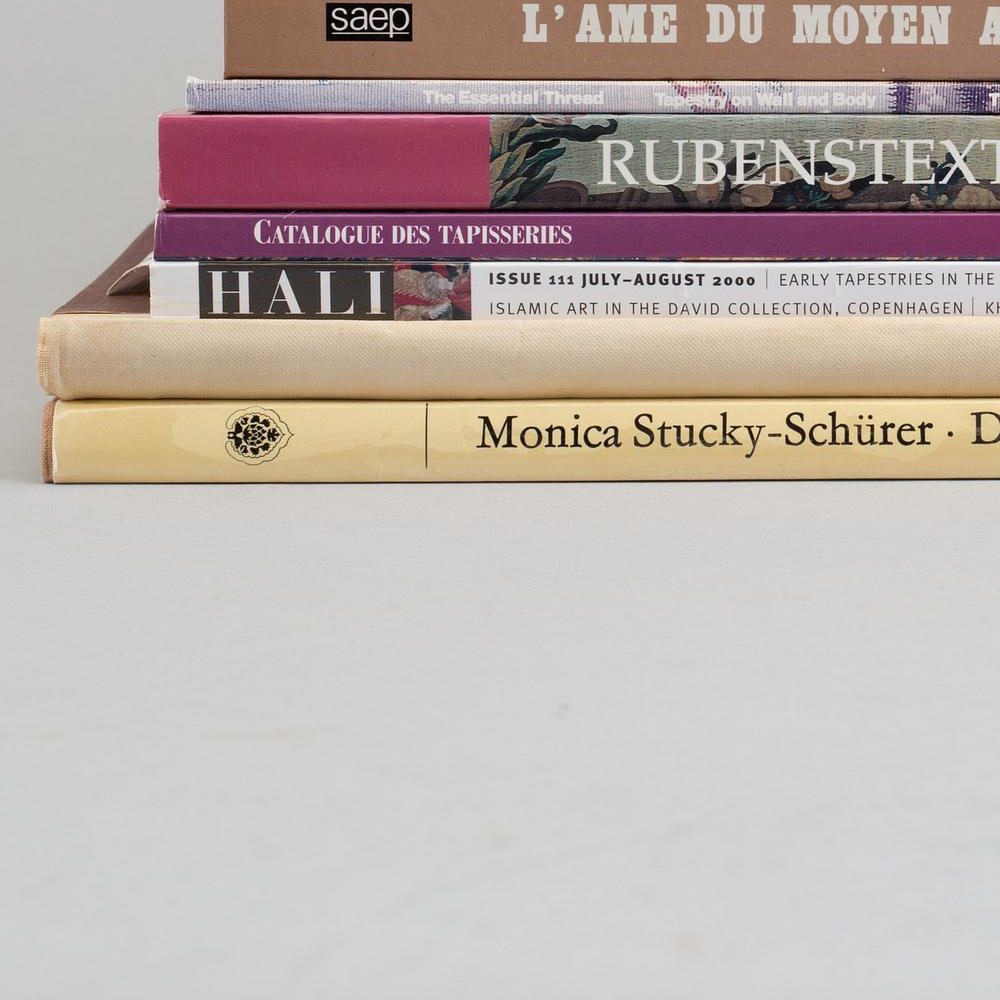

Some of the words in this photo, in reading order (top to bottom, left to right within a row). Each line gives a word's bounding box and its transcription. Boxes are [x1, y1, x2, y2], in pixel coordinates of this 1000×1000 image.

[330, 6, 410, 36] saep
[706, 4, 765, 45] DU
[793, 5, 952, 46] MOYEN
[423, 89, 459, 105] The
[462, 89, 539, 105] Essential
[544, 89, 604, 105] Thread
[655, 91, 728, 109] Tapestry
[731, 95, 751, 106] on
[755, 91, 792, 106] Wall
[797, 91, 829, 106] and
[832, 91, 877, 110] Body
[391, 222, 431, 246] DES
[438, 222, 573, 246] TAPISSERIES
[489, 272, 542, 286] ISSUE
[549, 275, 574, 286] 111
[713, 276, 756, 287] 2000
[779, 272, 829, 287] EARLY
[836, 272, 934, 286] TAPESTRIES
[941, 272, 958, 286] IN
[965, 272, 995, 286] THE
[207, 271, 386, 316] HALI
[490, 302, 560, 315] ISLAMIC
[567, 302, 598, 315] ART
[605, 302, 621, 315] IN
[629, 302, 660, 315] THE
[668, 302, 720, 315] DAVID
[728, 302, 839, 317] COLLECTION,
[847, 302, 964, 315] COPENHAGEN
[477, 415, 622, 451] Monica
[632, 410, 933, 460] Stucky-Schürer
